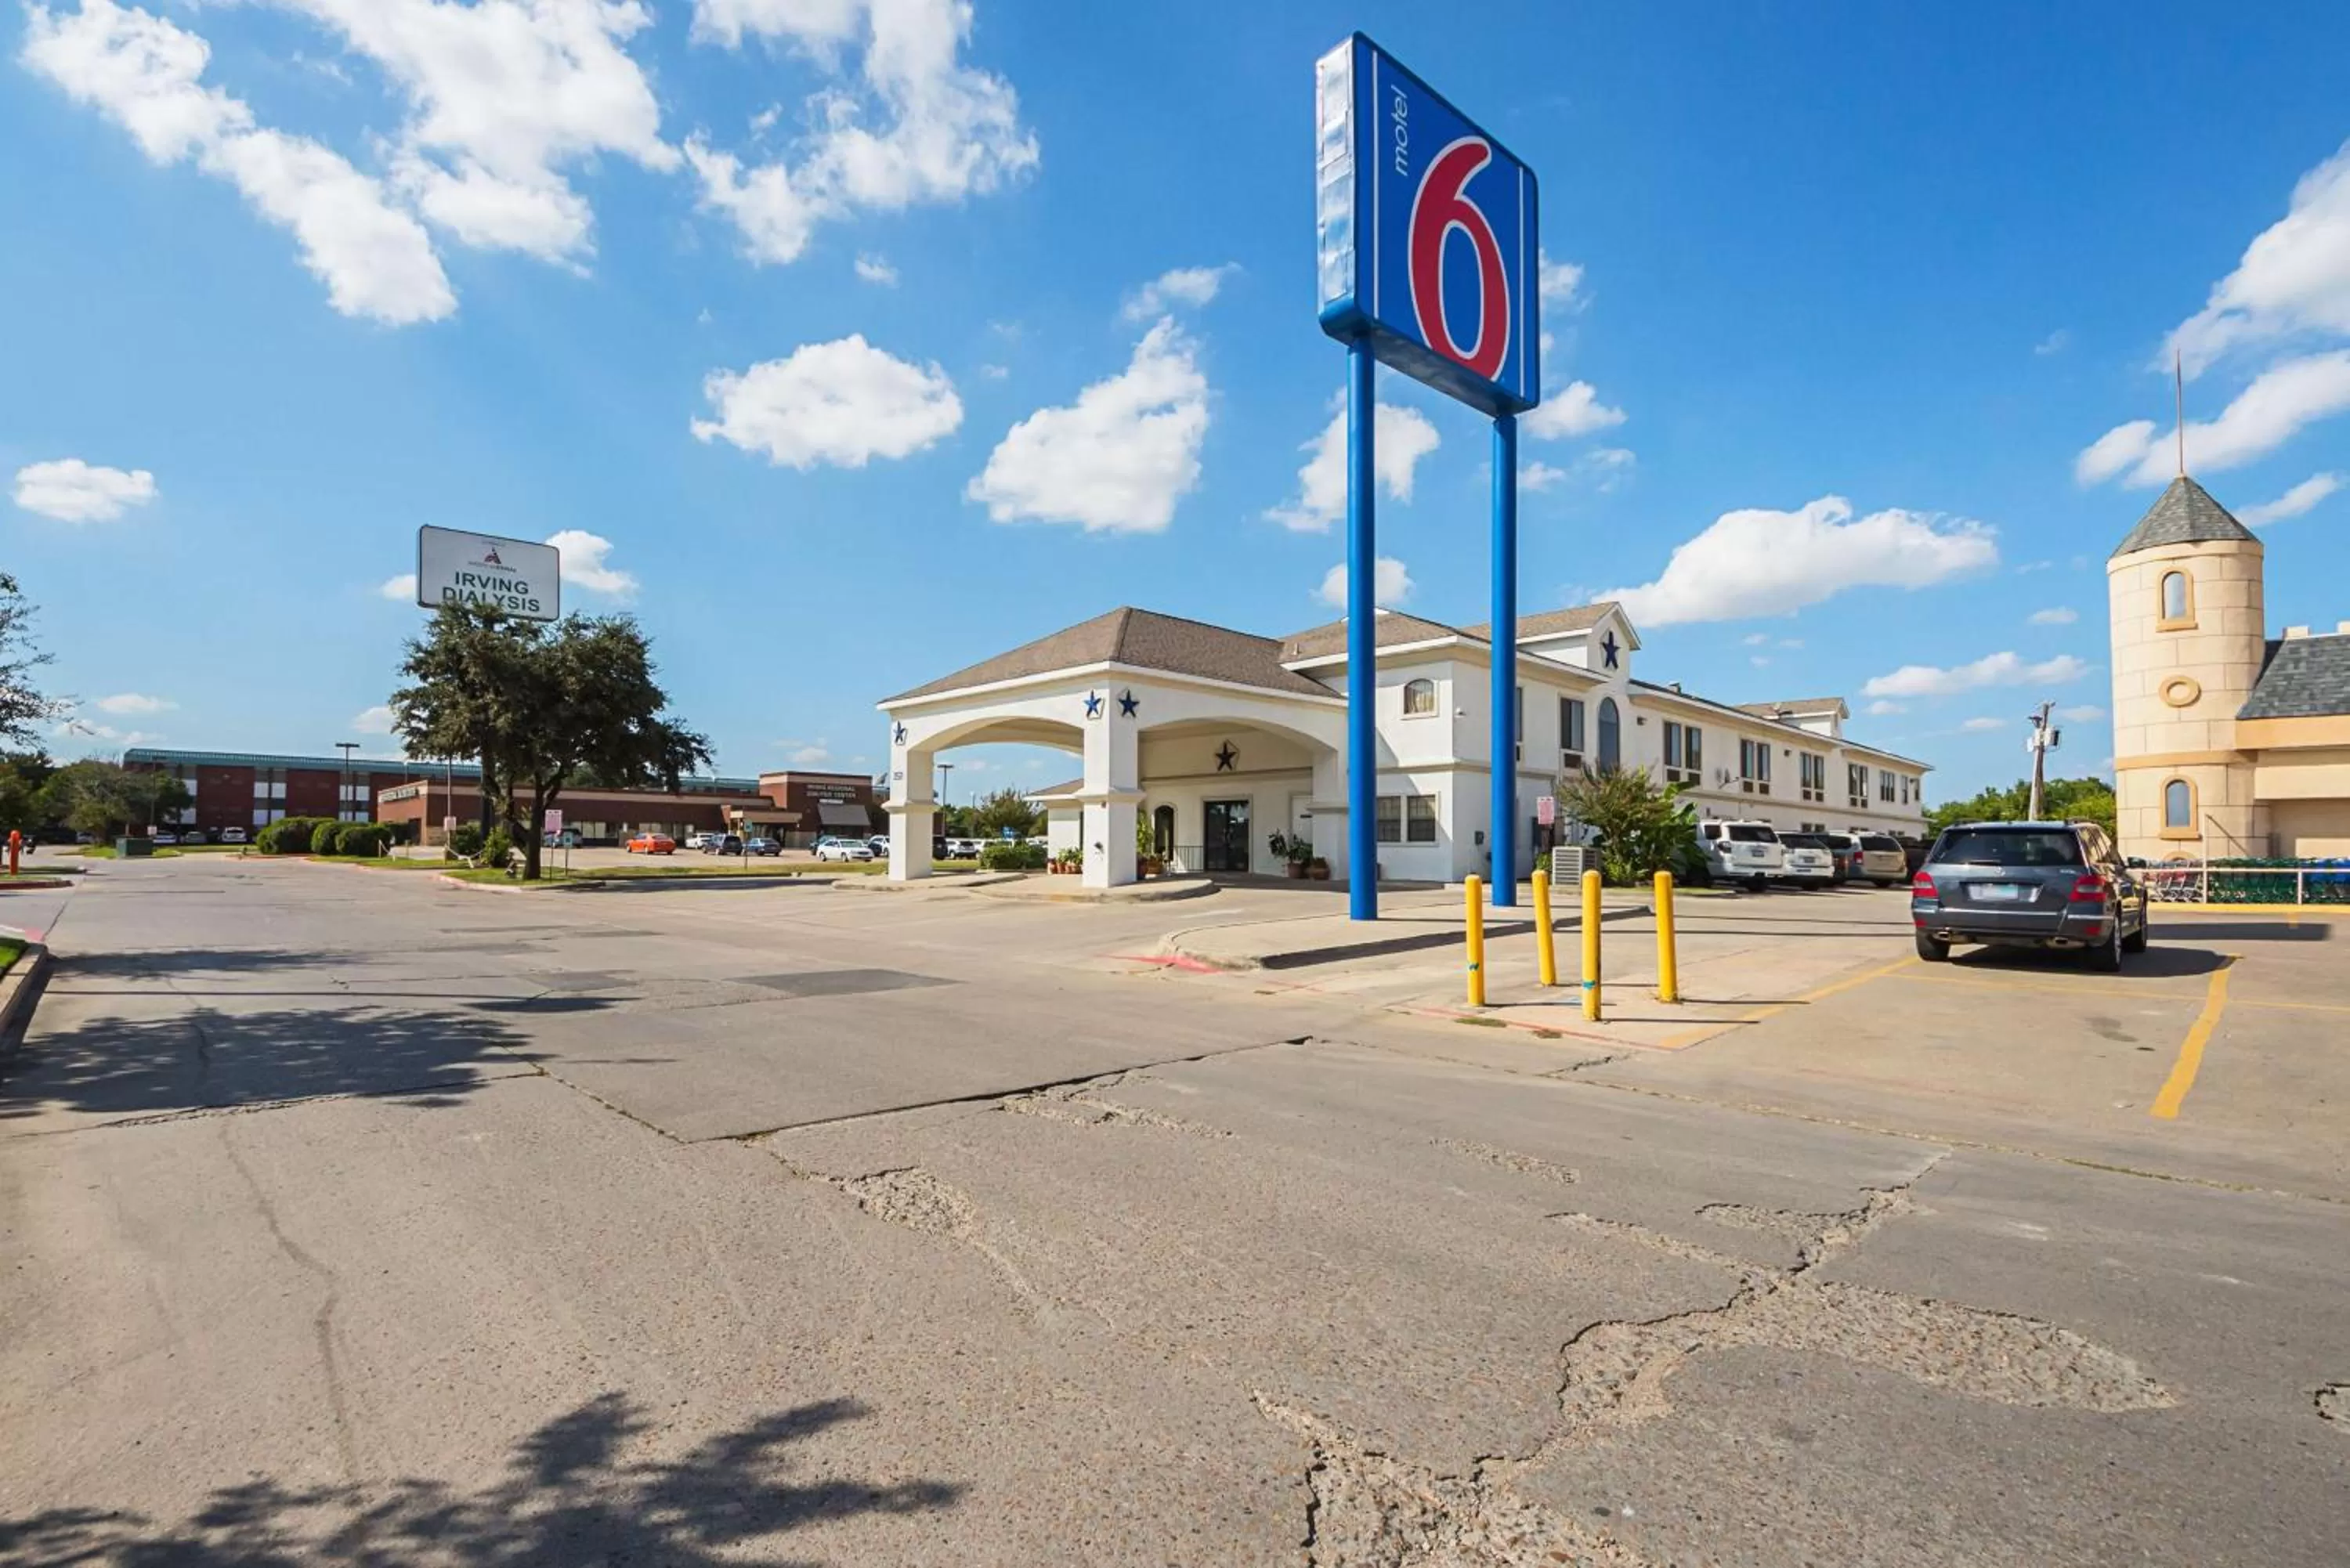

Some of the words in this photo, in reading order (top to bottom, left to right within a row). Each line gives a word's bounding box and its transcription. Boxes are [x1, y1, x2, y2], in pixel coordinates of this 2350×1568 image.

[1391, 84, 1408, 177] motel
[1408, 135, 1511, 383] 6
[455, 571, 529, 594] IRVING
